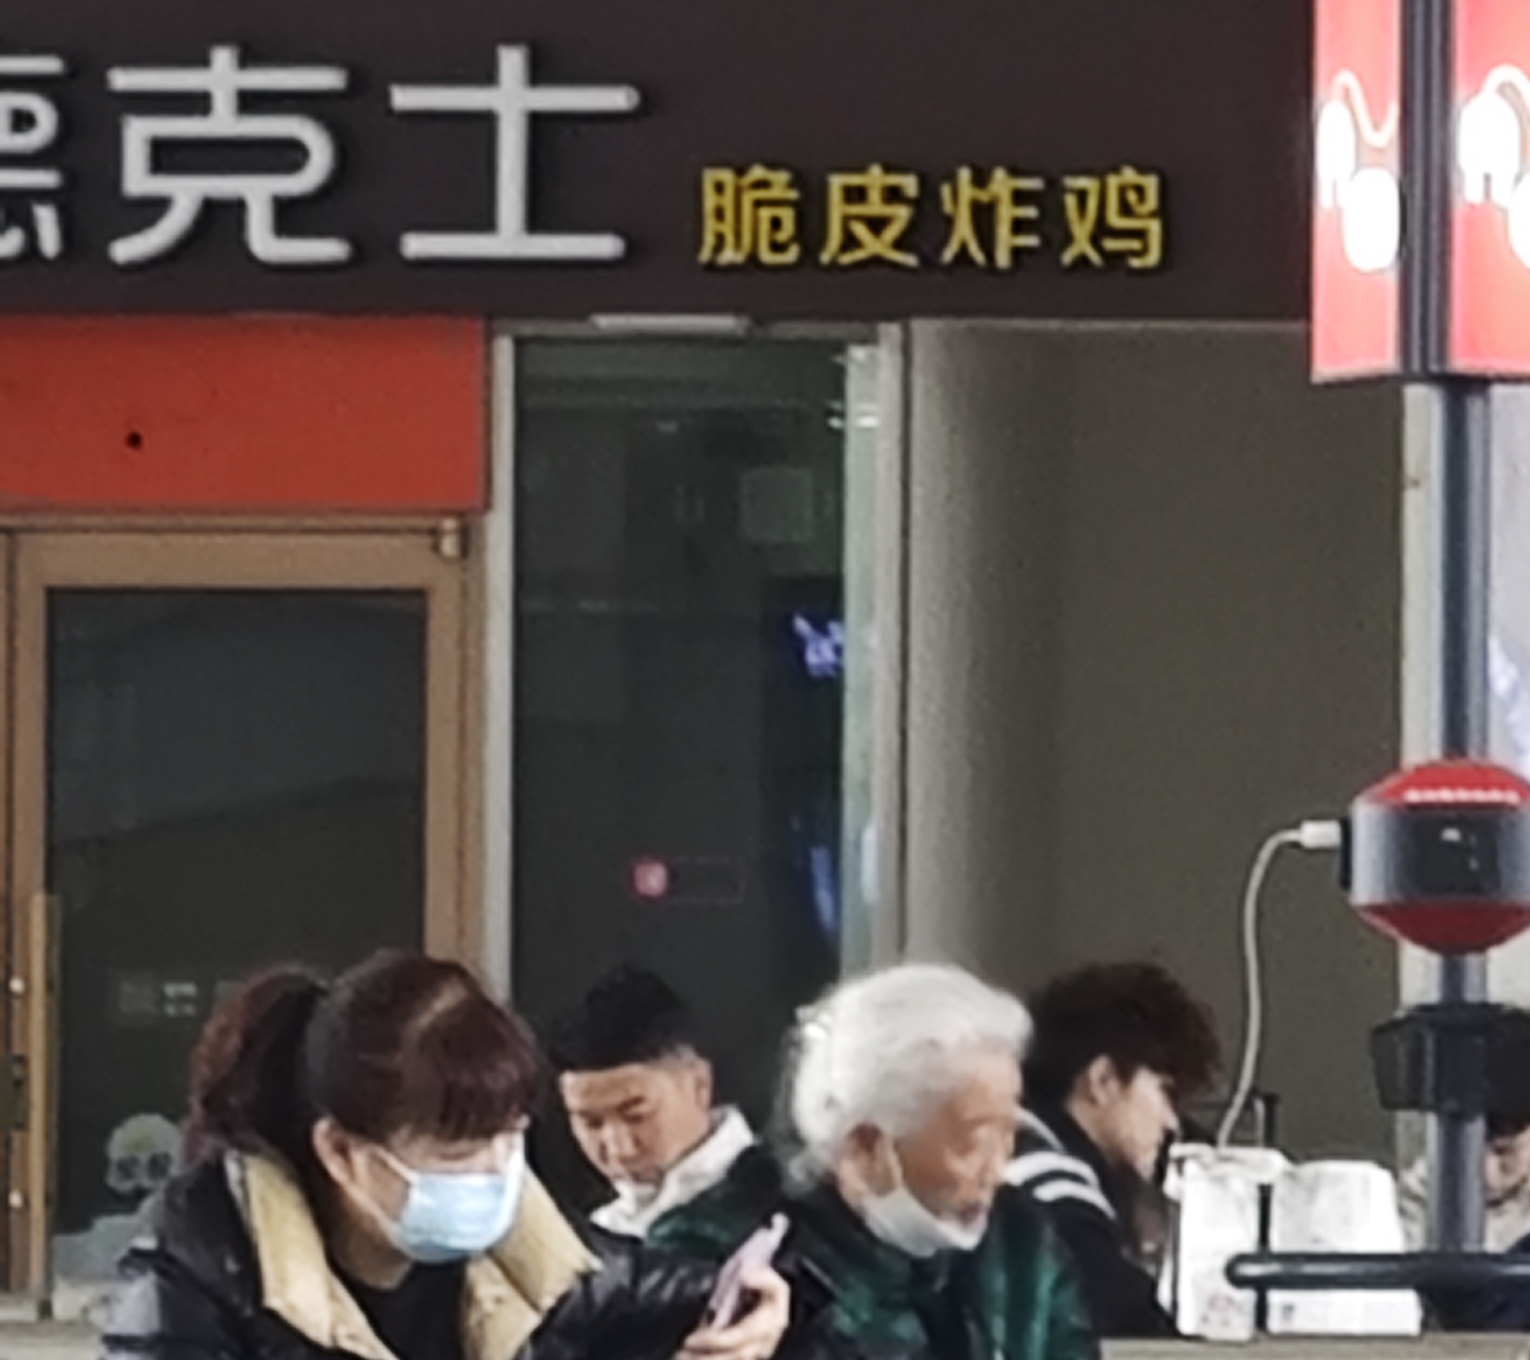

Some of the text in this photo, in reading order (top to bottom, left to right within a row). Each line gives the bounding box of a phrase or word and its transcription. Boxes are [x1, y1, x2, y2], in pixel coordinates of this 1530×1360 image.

[0, 44, 641, 265] 克士
[697, 163, 1164, 270] 脆皮炸鸡
